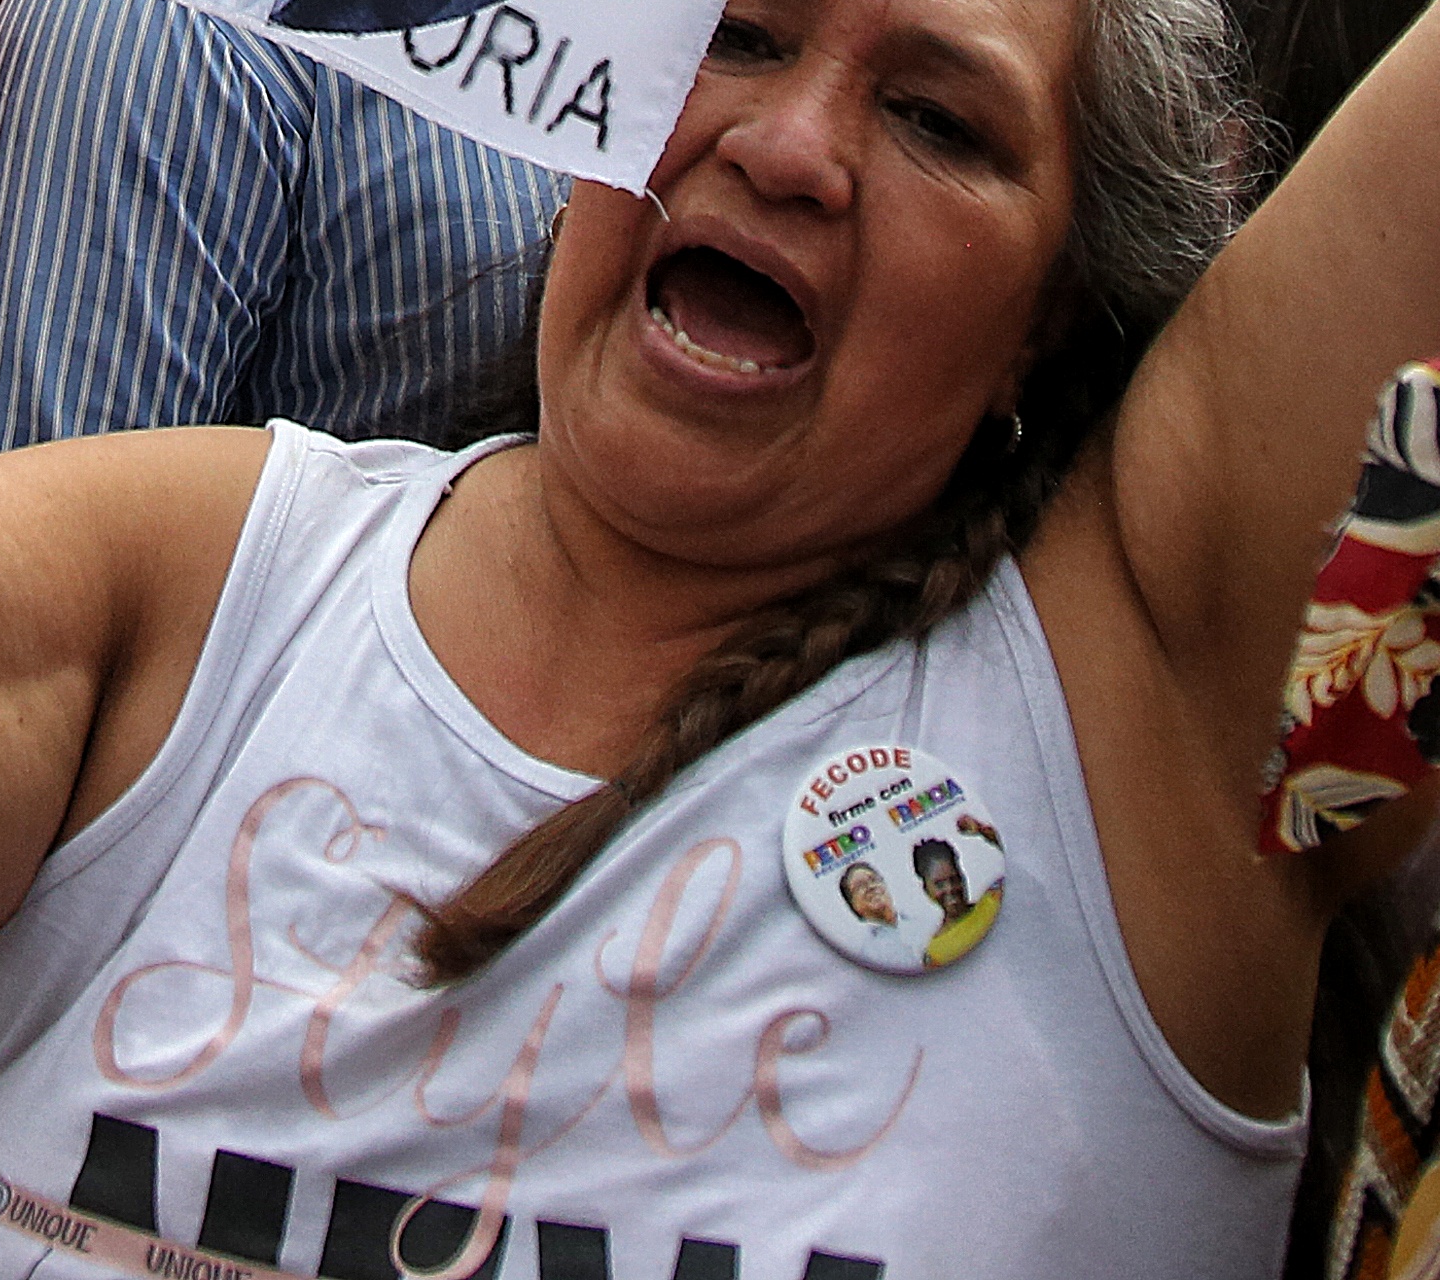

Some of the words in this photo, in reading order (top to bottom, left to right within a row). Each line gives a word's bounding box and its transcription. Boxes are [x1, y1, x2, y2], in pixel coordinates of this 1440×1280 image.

[801, 748, 912, 817] FECODE
[828, 794, 876, 828] firme
[880, 777, 913, 802] con
[803, 825, 871, 872] PETRO
[94, 776, 923, 1278] Style
[10, 1195, 99, 1253] UNIQUE
